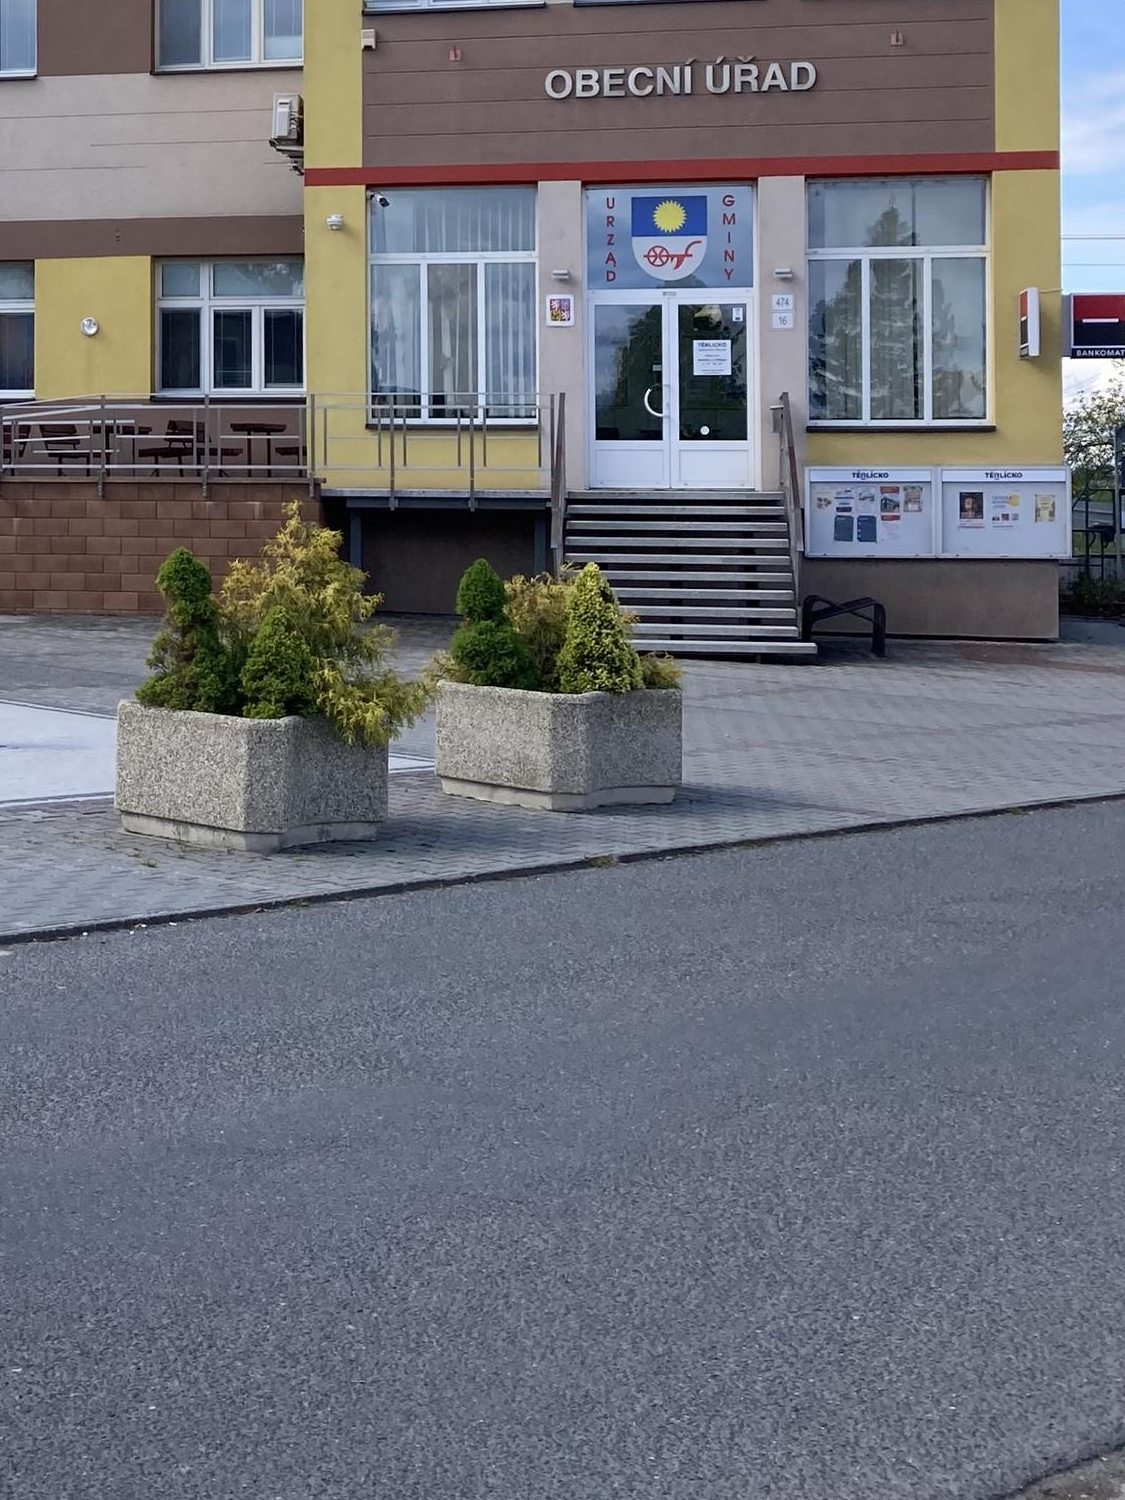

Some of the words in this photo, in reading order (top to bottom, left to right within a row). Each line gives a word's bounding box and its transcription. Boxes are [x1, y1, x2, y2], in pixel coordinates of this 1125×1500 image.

[544, 57, 697, 100] OBECNÍ
[705, 55, 817, 94] ÚŘAD
[605, 197, 617, 282] URZĄD
[722, 194, 736, 281] GMINY
[776, 297, 789, 307] 474
[778, 315, 787, 326] 16
[1076, 349, 1125, 357] BANKOMAT
